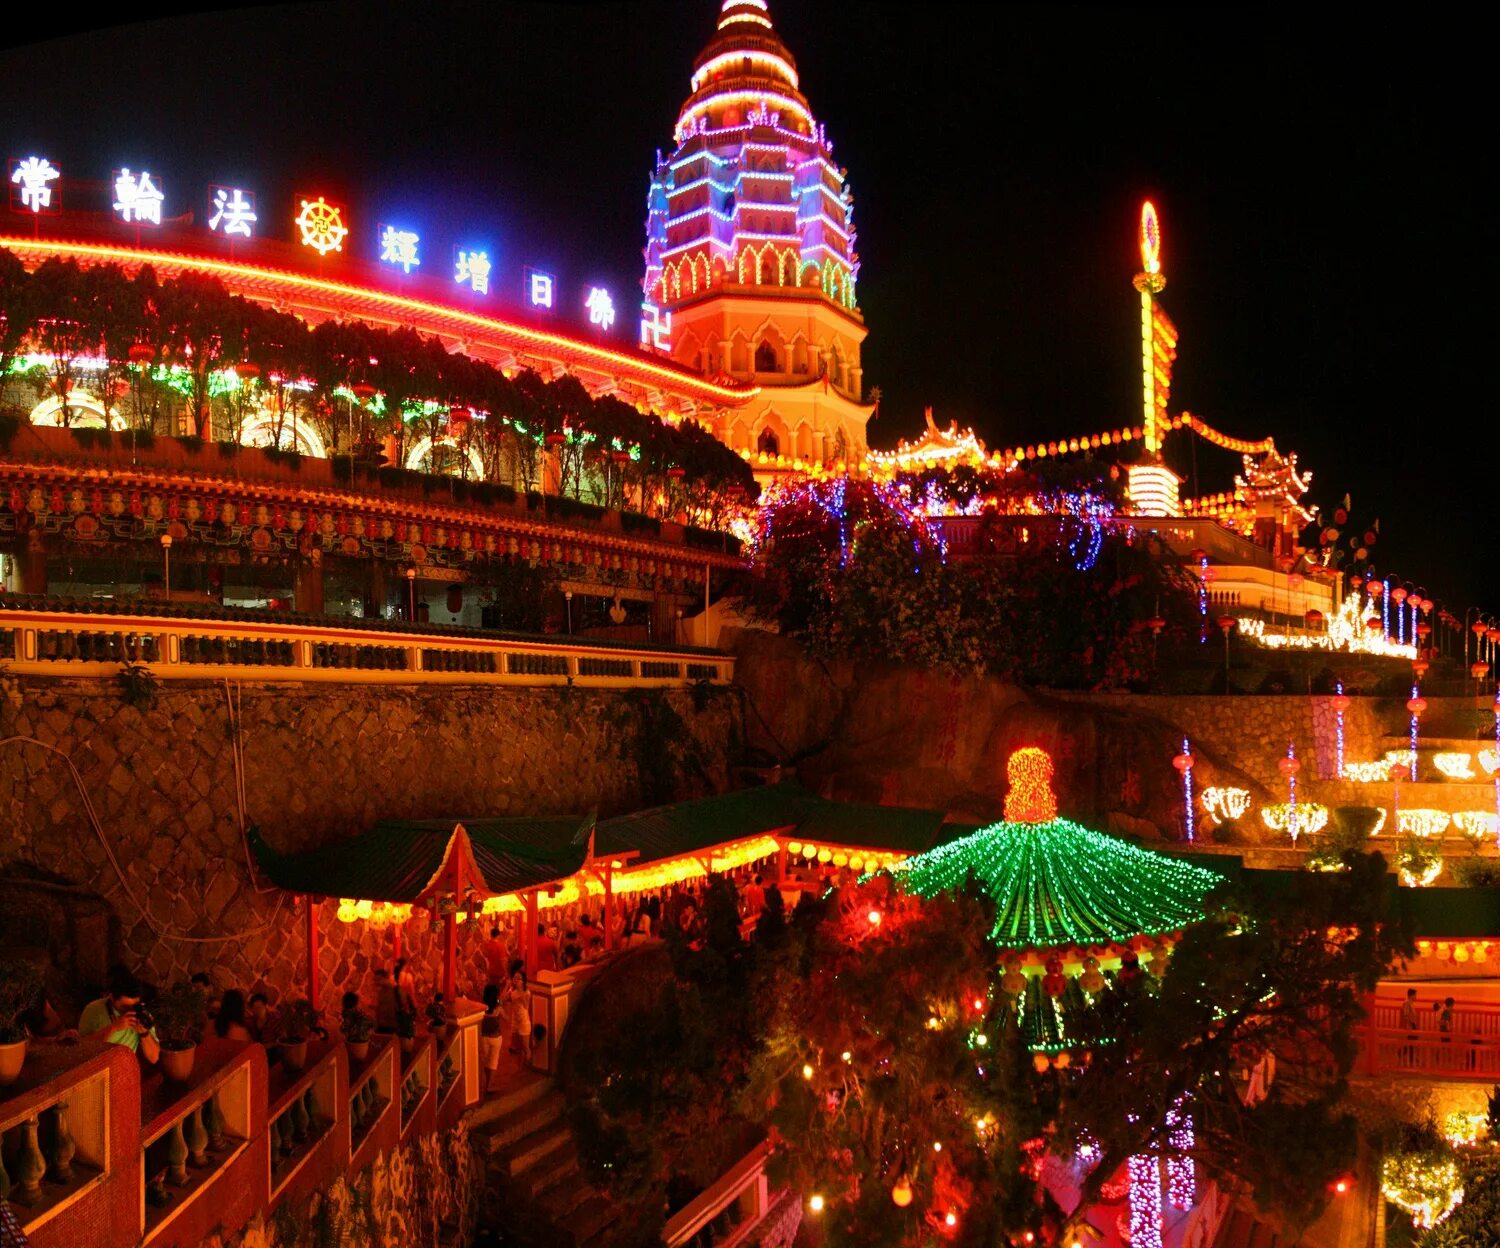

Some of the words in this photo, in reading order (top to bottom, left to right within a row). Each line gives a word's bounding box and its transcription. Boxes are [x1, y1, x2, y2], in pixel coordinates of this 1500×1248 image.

[11, 156, 61, 213] 常
[112, 167, 165, 225] 輪
[208, 189, 257, 237] 法
[380, 225, 421, 274] 輝
[454, 250, 492, 295] 增
[530, 273, 553, 309] 日
[585, 286, 616, 331] 佛
